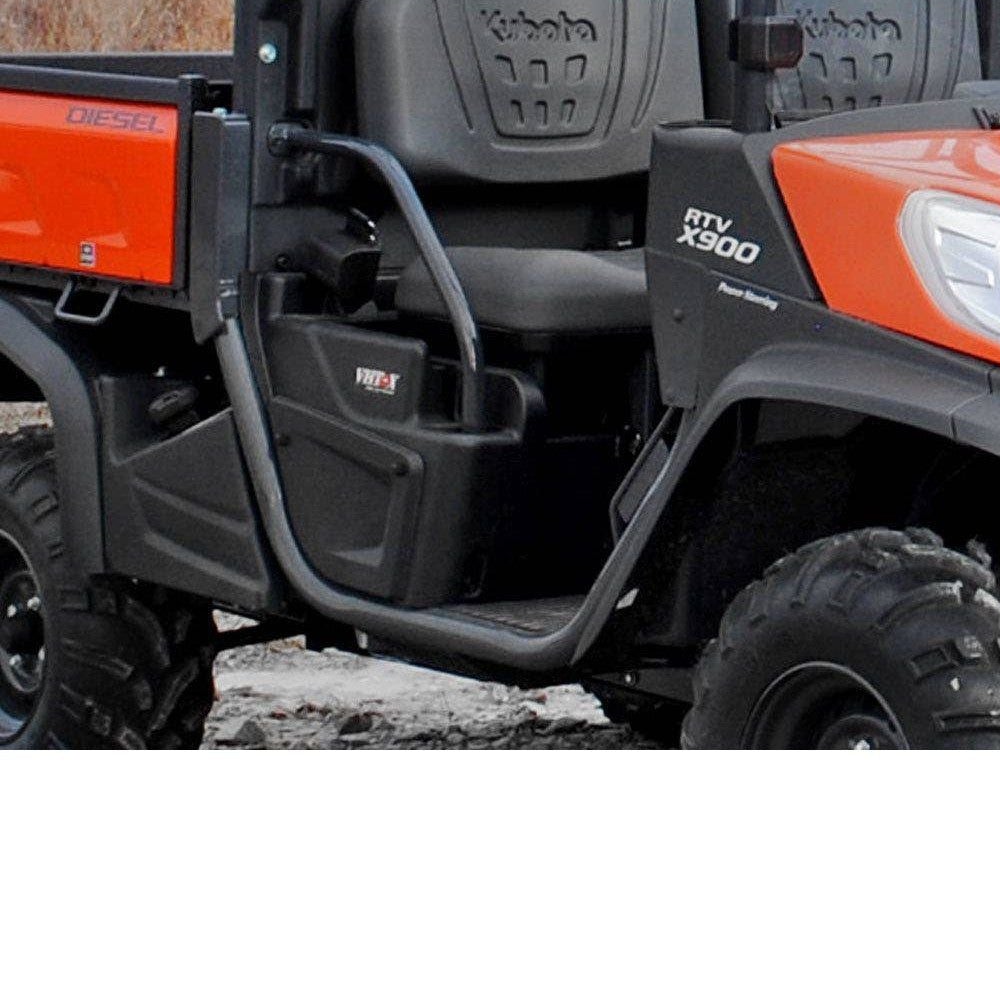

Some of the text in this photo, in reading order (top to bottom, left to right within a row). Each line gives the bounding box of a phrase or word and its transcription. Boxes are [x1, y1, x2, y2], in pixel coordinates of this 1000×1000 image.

[480, 10, 598, 42] Kubota
[794, 8, 902, 41] Kubota
[65, 105, 165, 134] DIESEL
[683, 206, 733, 234] RTV
[675, 224, 761, 265] X900
